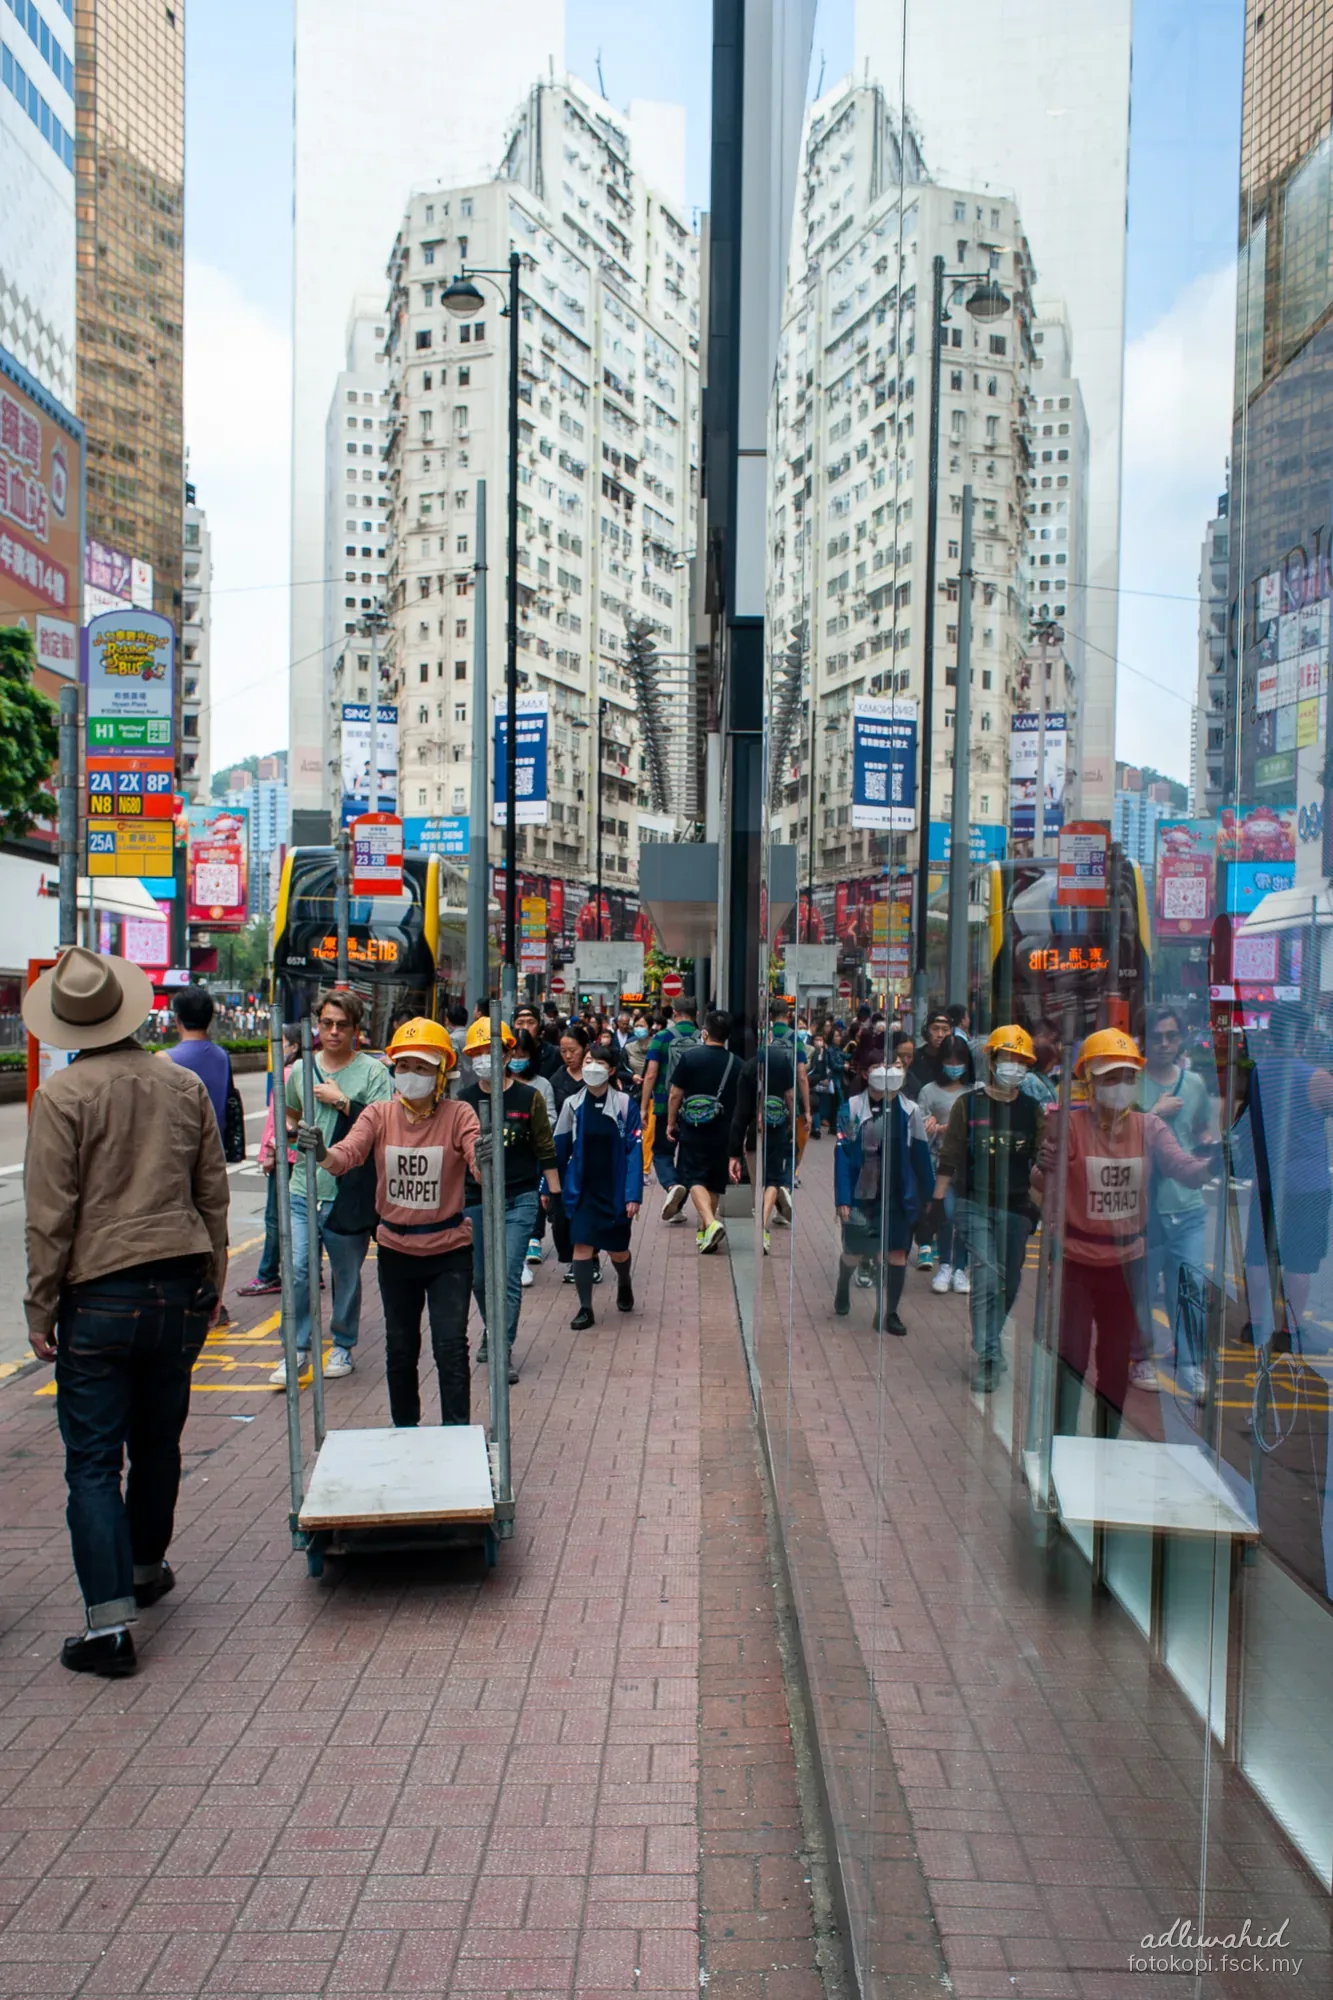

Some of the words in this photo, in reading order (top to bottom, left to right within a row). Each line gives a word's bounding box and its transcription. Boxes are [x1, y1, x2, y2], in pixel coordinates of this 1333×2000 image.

[95, 723, 114, 738] H1
[90, 773, 112, 791] 2A
[119, 773, 140, 792] 2X
[147, 774, 170, 792] 8P
[91, 795, 112, 814] N8
[118, 795, 141, 814] N680
[90, 833, 114, 851] 25A
[357, 855, 368, 865] 23
[367, 939, 398, 961] E11B
[286, 956, 306, 966] 6574
[397, 1154, 429, 1176] RED
[388, 1178, 439, 1202] CARPET
